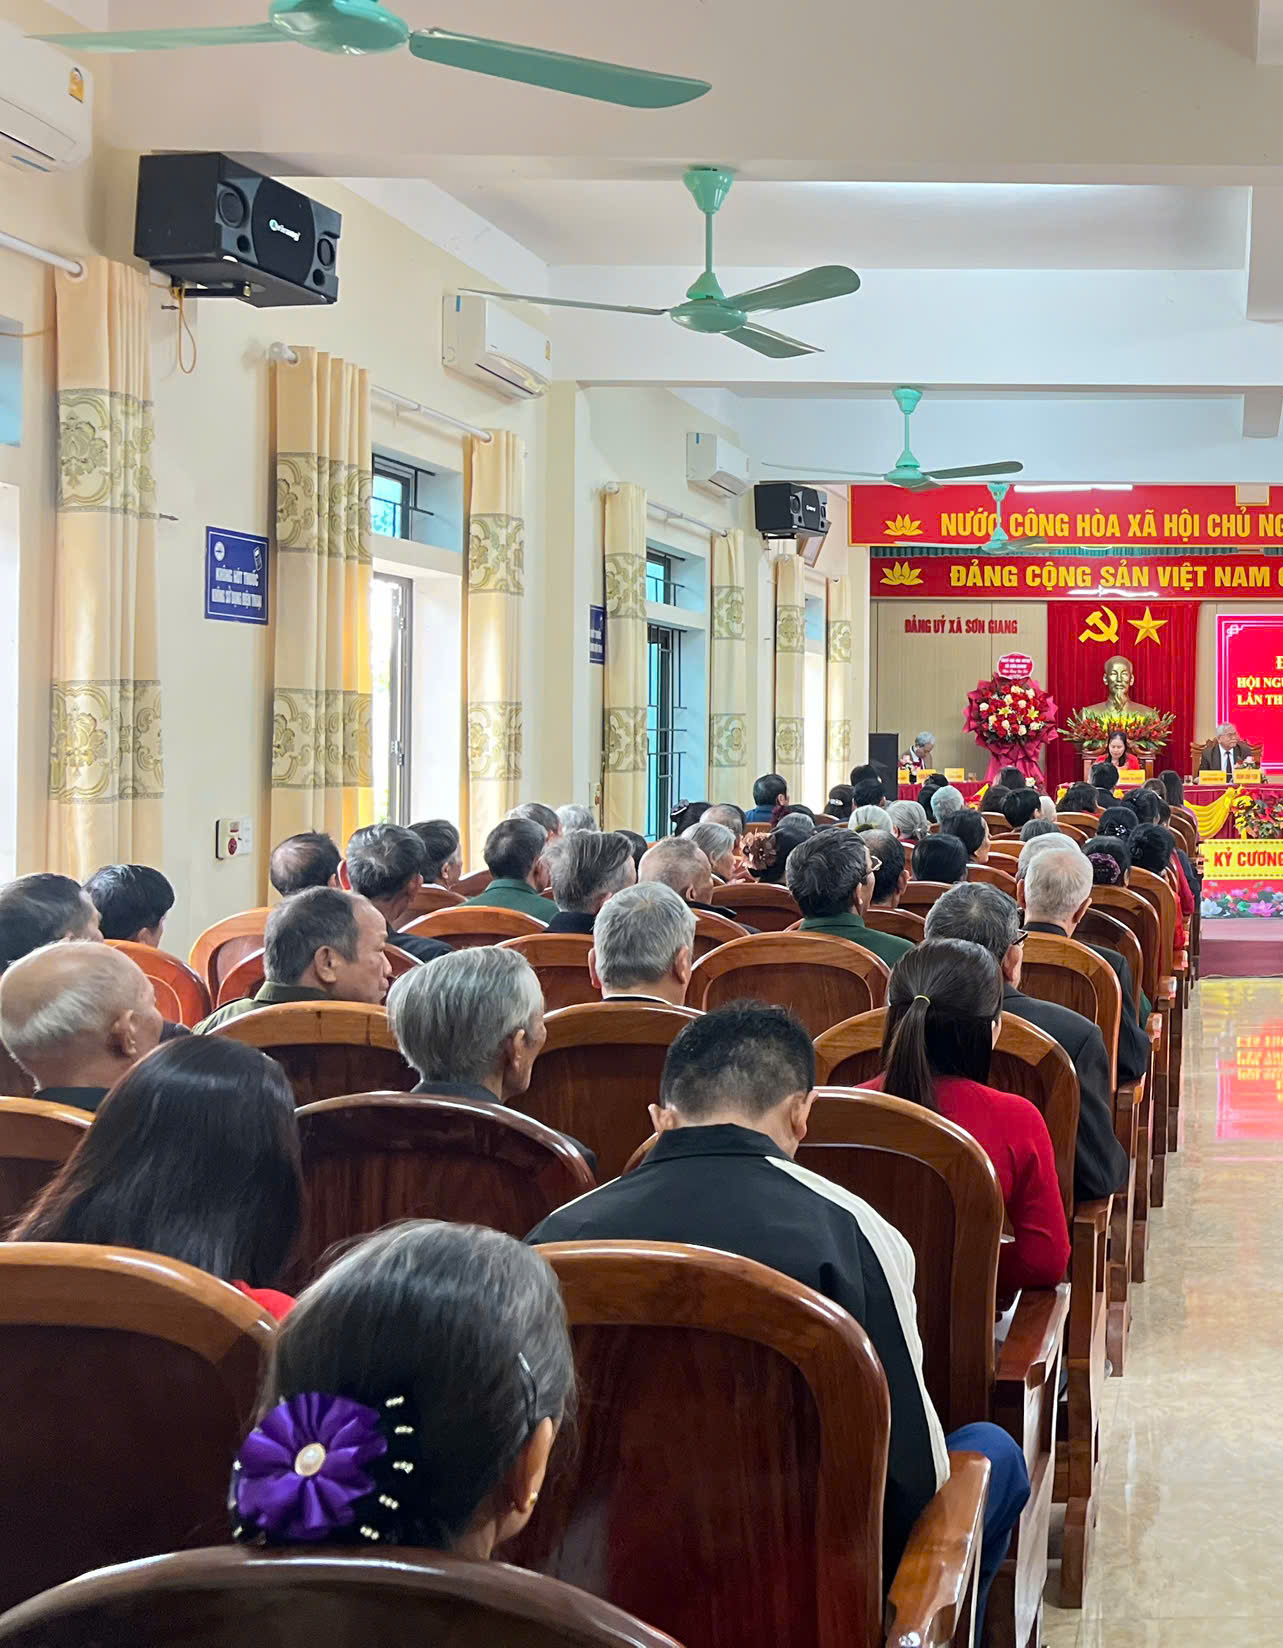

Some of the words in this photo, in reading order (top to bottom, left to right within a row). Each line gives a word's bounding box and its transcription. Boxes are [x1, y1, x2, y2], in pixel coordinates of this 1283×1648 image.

[941, 507, 1002, 536] NƯỚC
[1009, 508, 1069, 537] CÔNG
[1076, 508, 1121, 537] HÒA
[1127, 509, 1157, 536] XÃ
[1163, 508, 1200, 542] HỘI
[1207, 506, 1250, 537] CHỦ
[950, 559, 1018, 587] ĐẢNG
[1025, 561, 1091, 591] CỘNG
[1100, 559, 1149, 587] SẢN
[1157, 562, 1208, 591] VIỆT
[1214, 566, 1270, 587] NAM
[948, 617, 962, 633] XÃ
[965, 618, 985, 633] SƠN
[988, 619, 1018, 634] GIANG
[1237, 675, 1261, 690] HỘI
